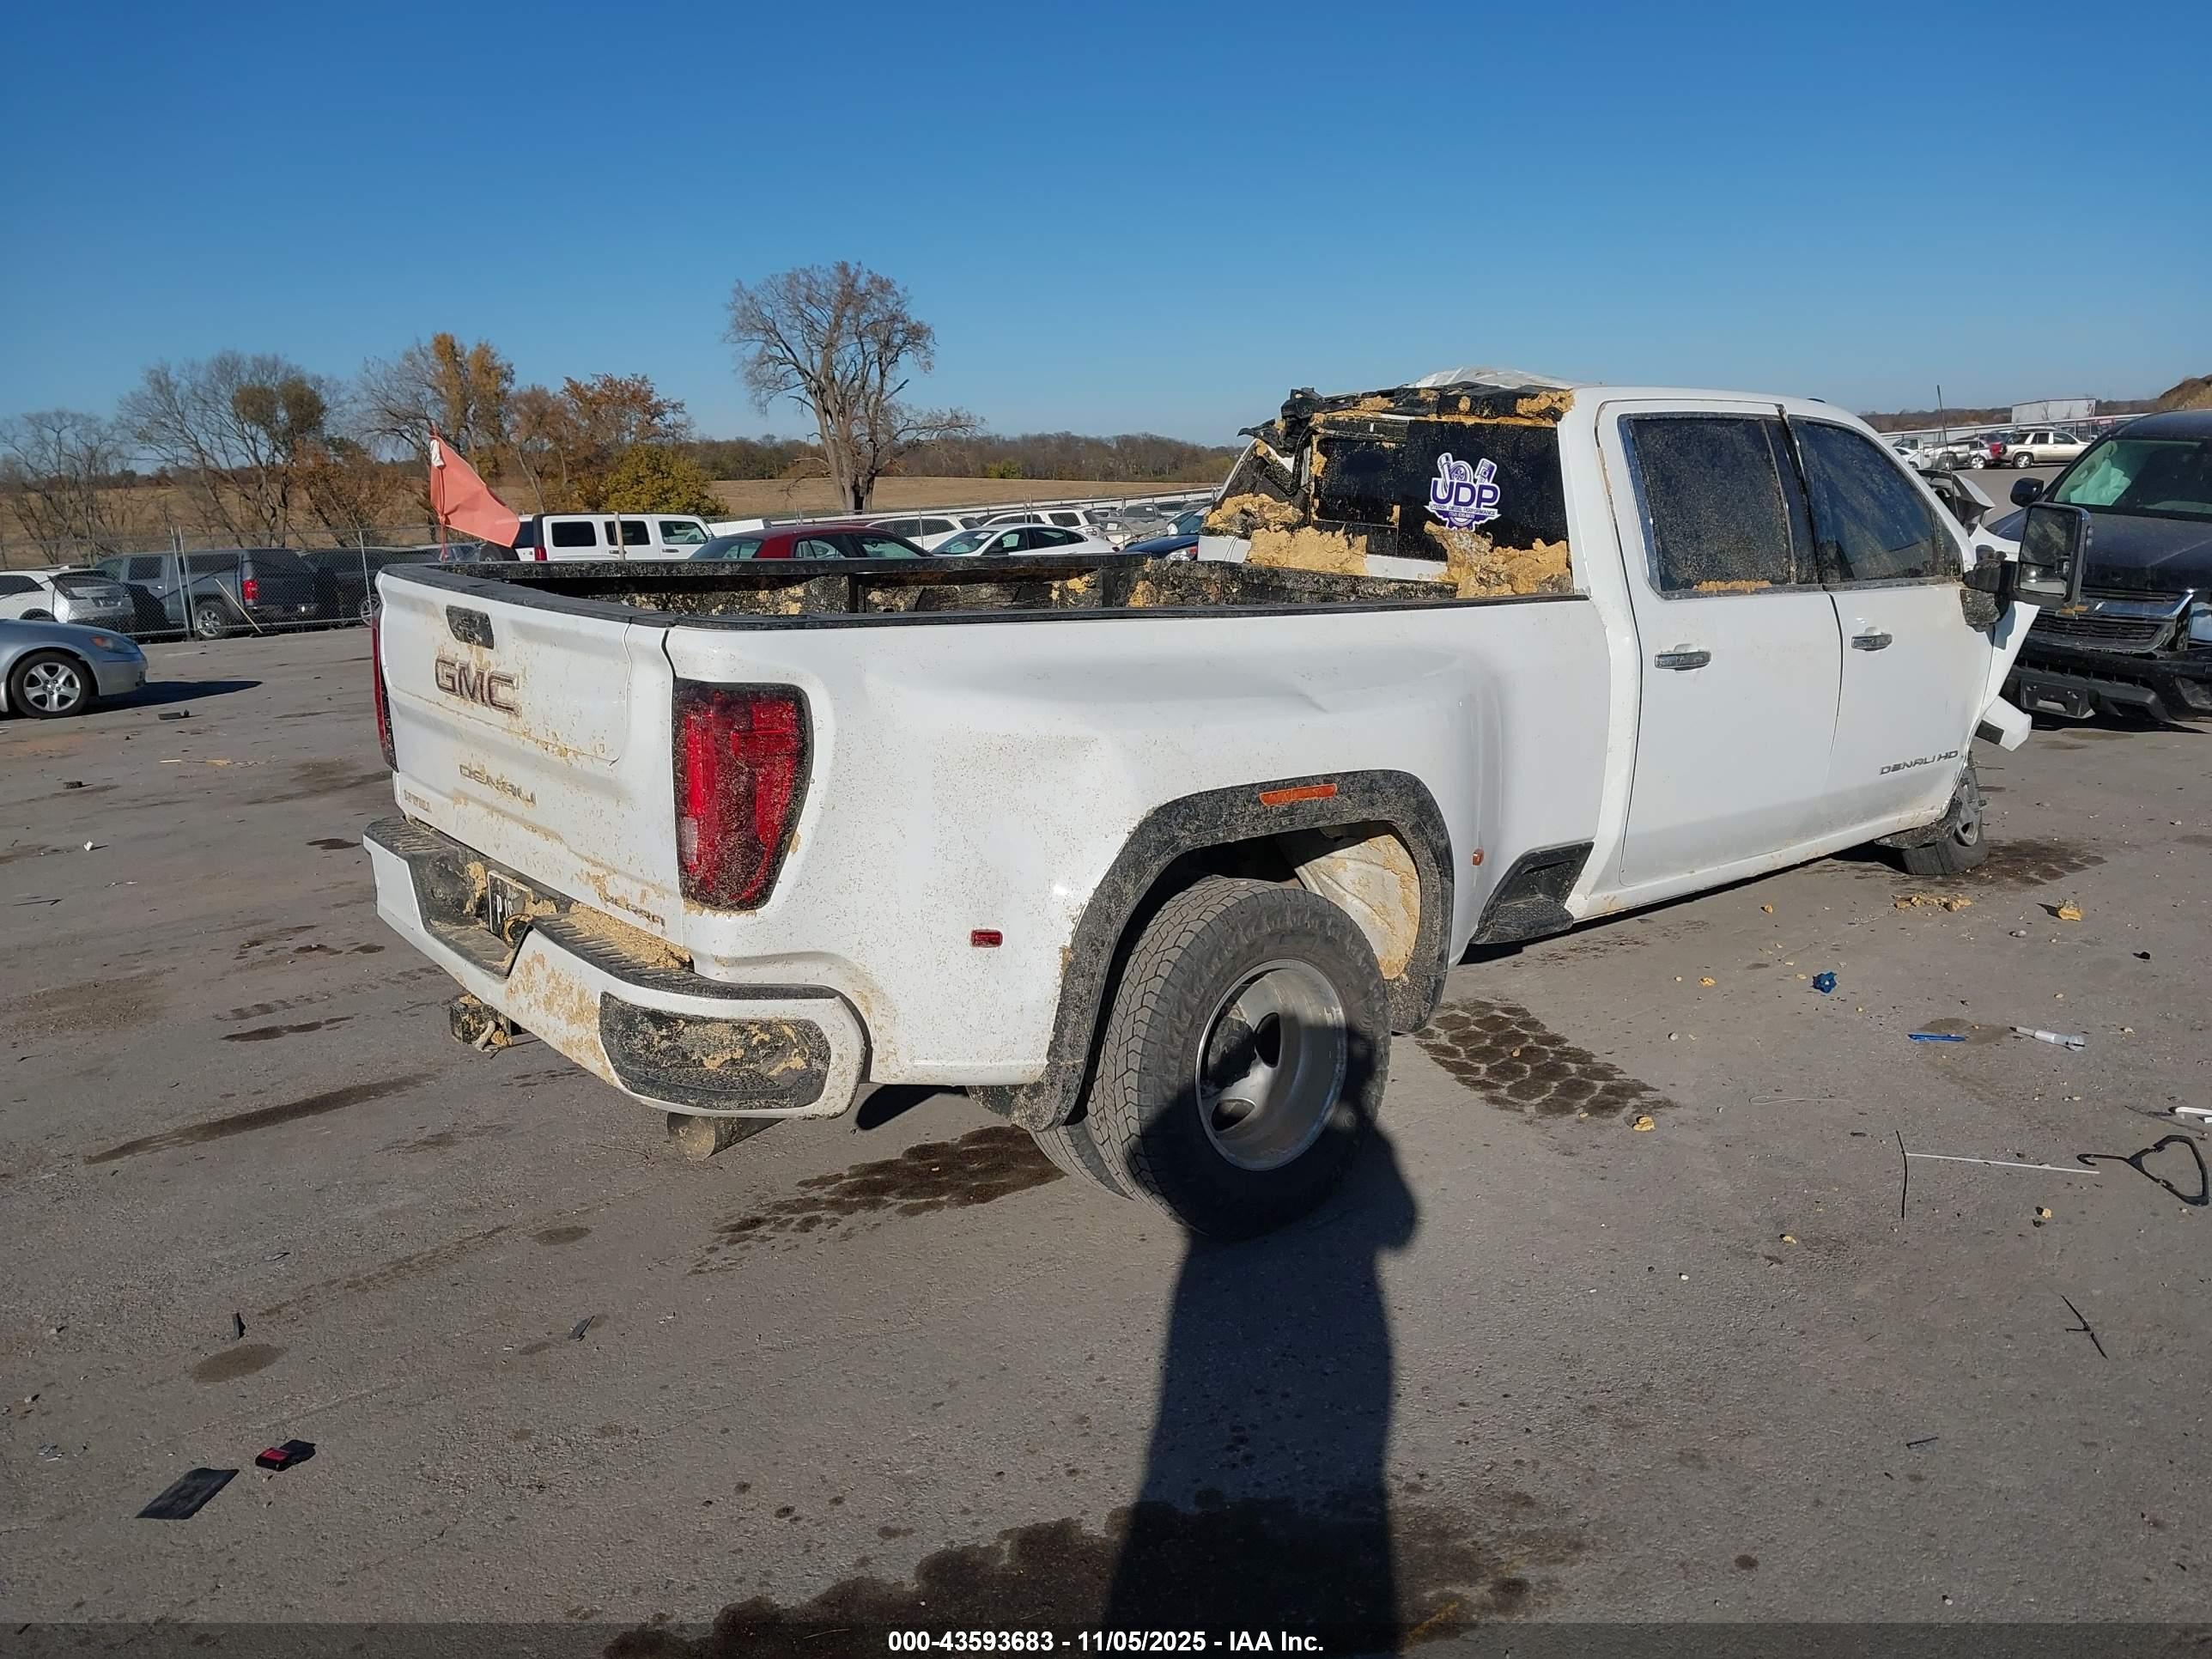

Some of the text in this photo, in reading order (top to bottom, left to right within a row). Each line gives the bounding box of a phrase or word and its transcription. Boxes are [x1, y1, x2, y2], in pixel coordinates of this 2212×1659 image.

[1431, 479, 1499, 509] UDP
[1463, 507, 1497, 516] PERFORMANCE
[434, 657, 522, 717] GMC
[1880, 750, 1959, 775] DENALI HD
[459, 763, 537, 805] DENALI
